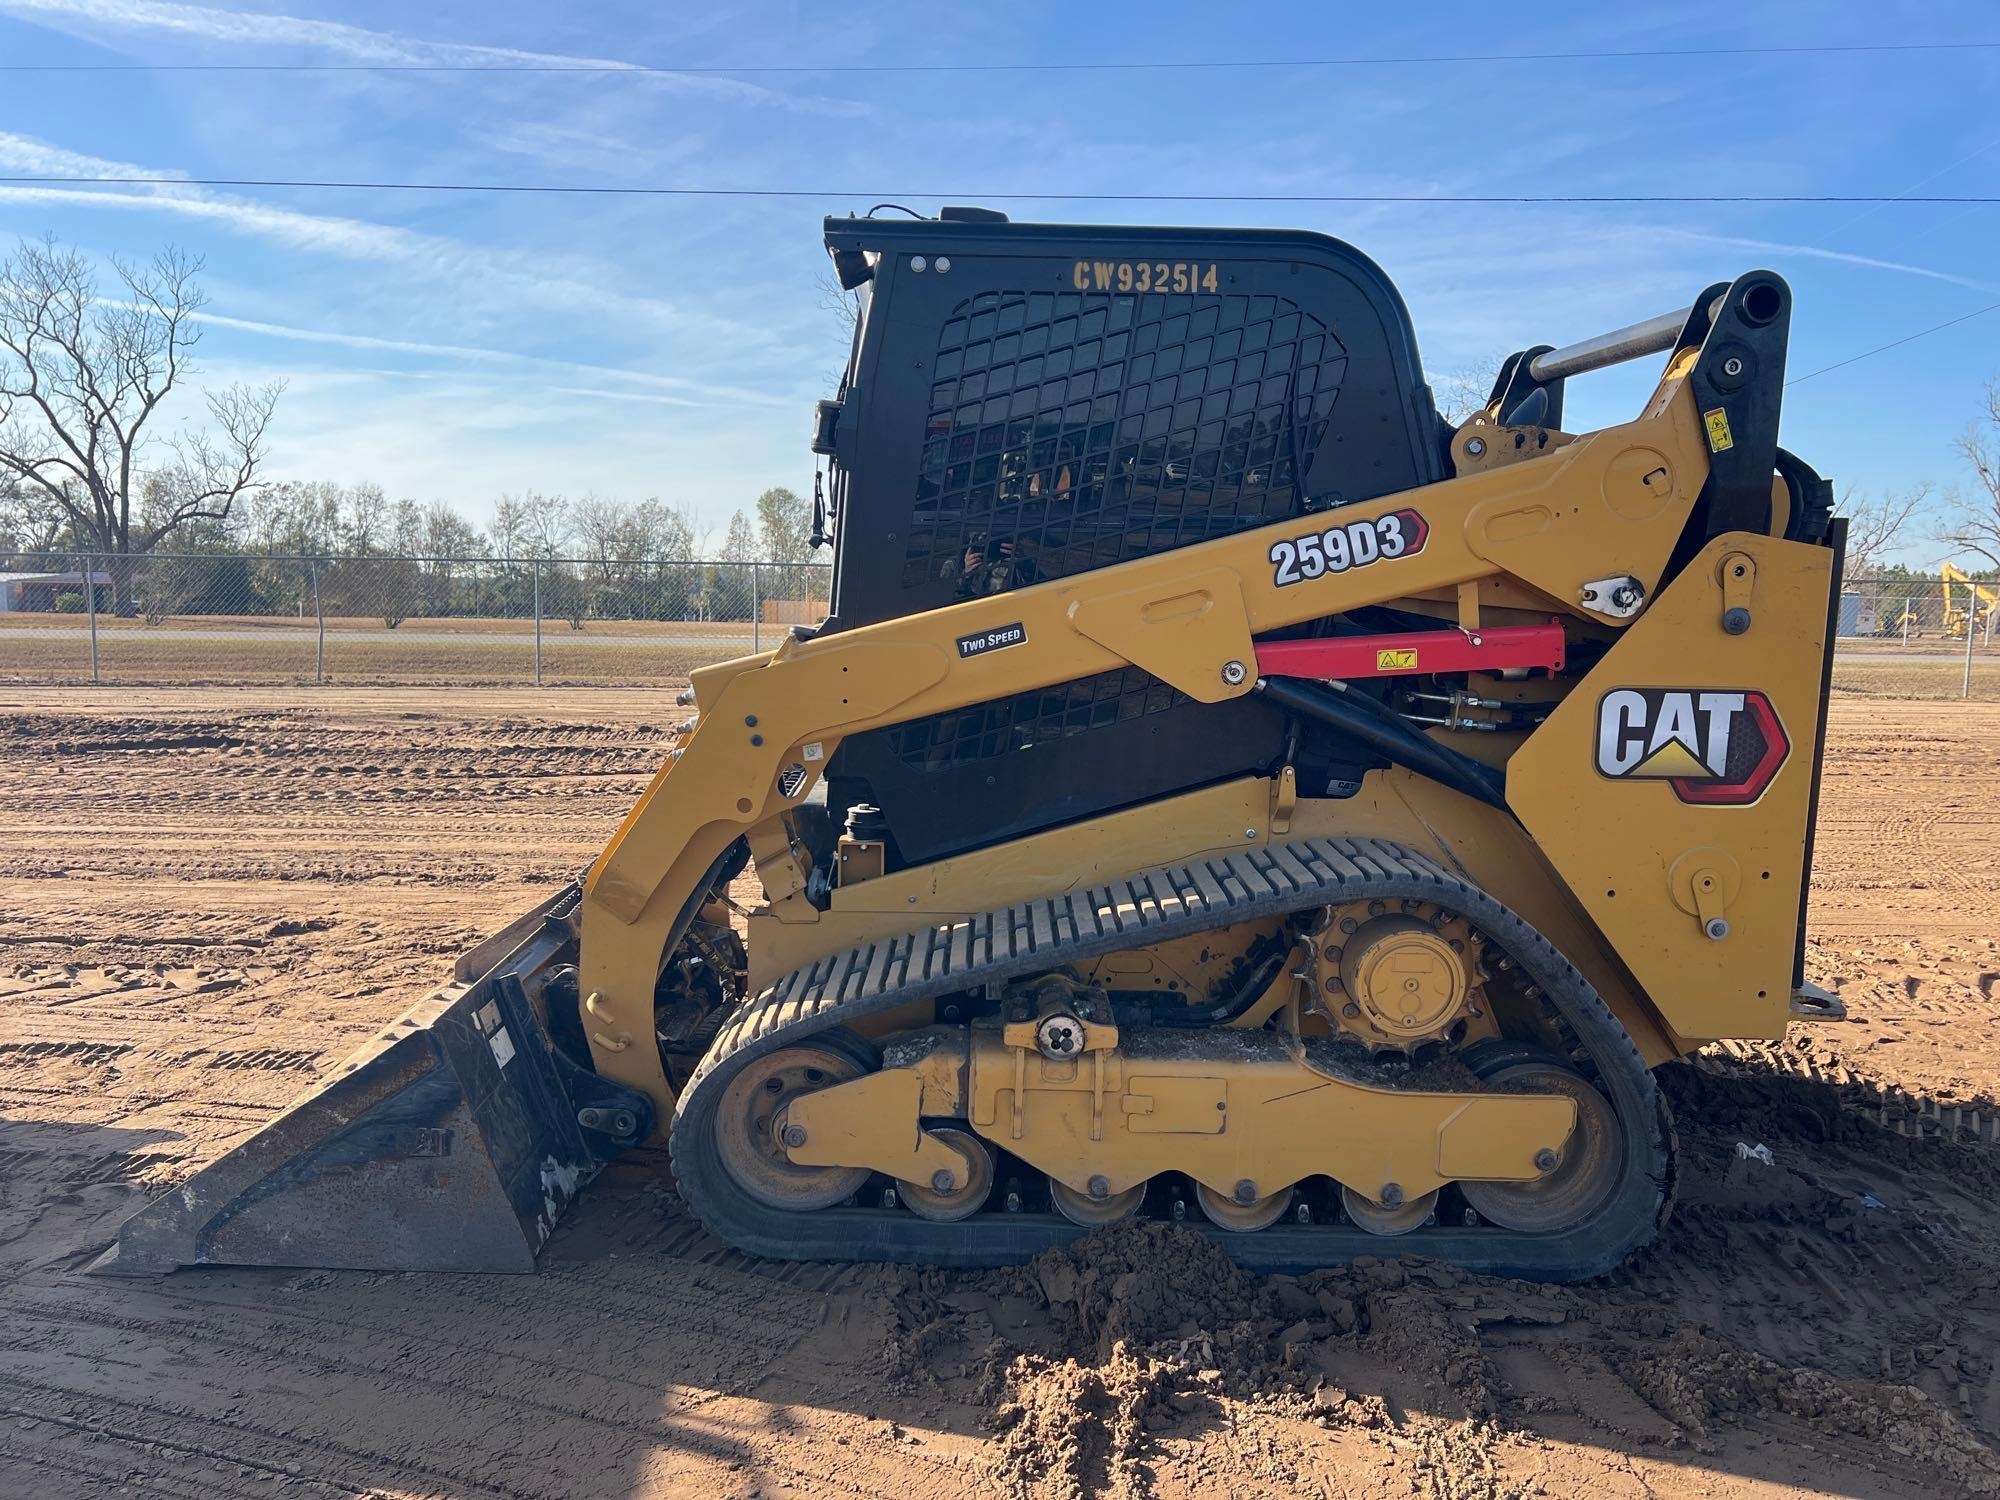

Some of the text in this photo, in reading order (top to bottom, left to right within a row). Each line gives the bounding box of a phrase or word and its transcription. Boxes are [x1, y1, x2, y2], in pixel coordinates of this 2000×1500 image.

[1073, 261, 1218, 293] CW932514
[1271, 515, 1405, 585] 259D3
[1598, 690, 1745, 777] CAT
